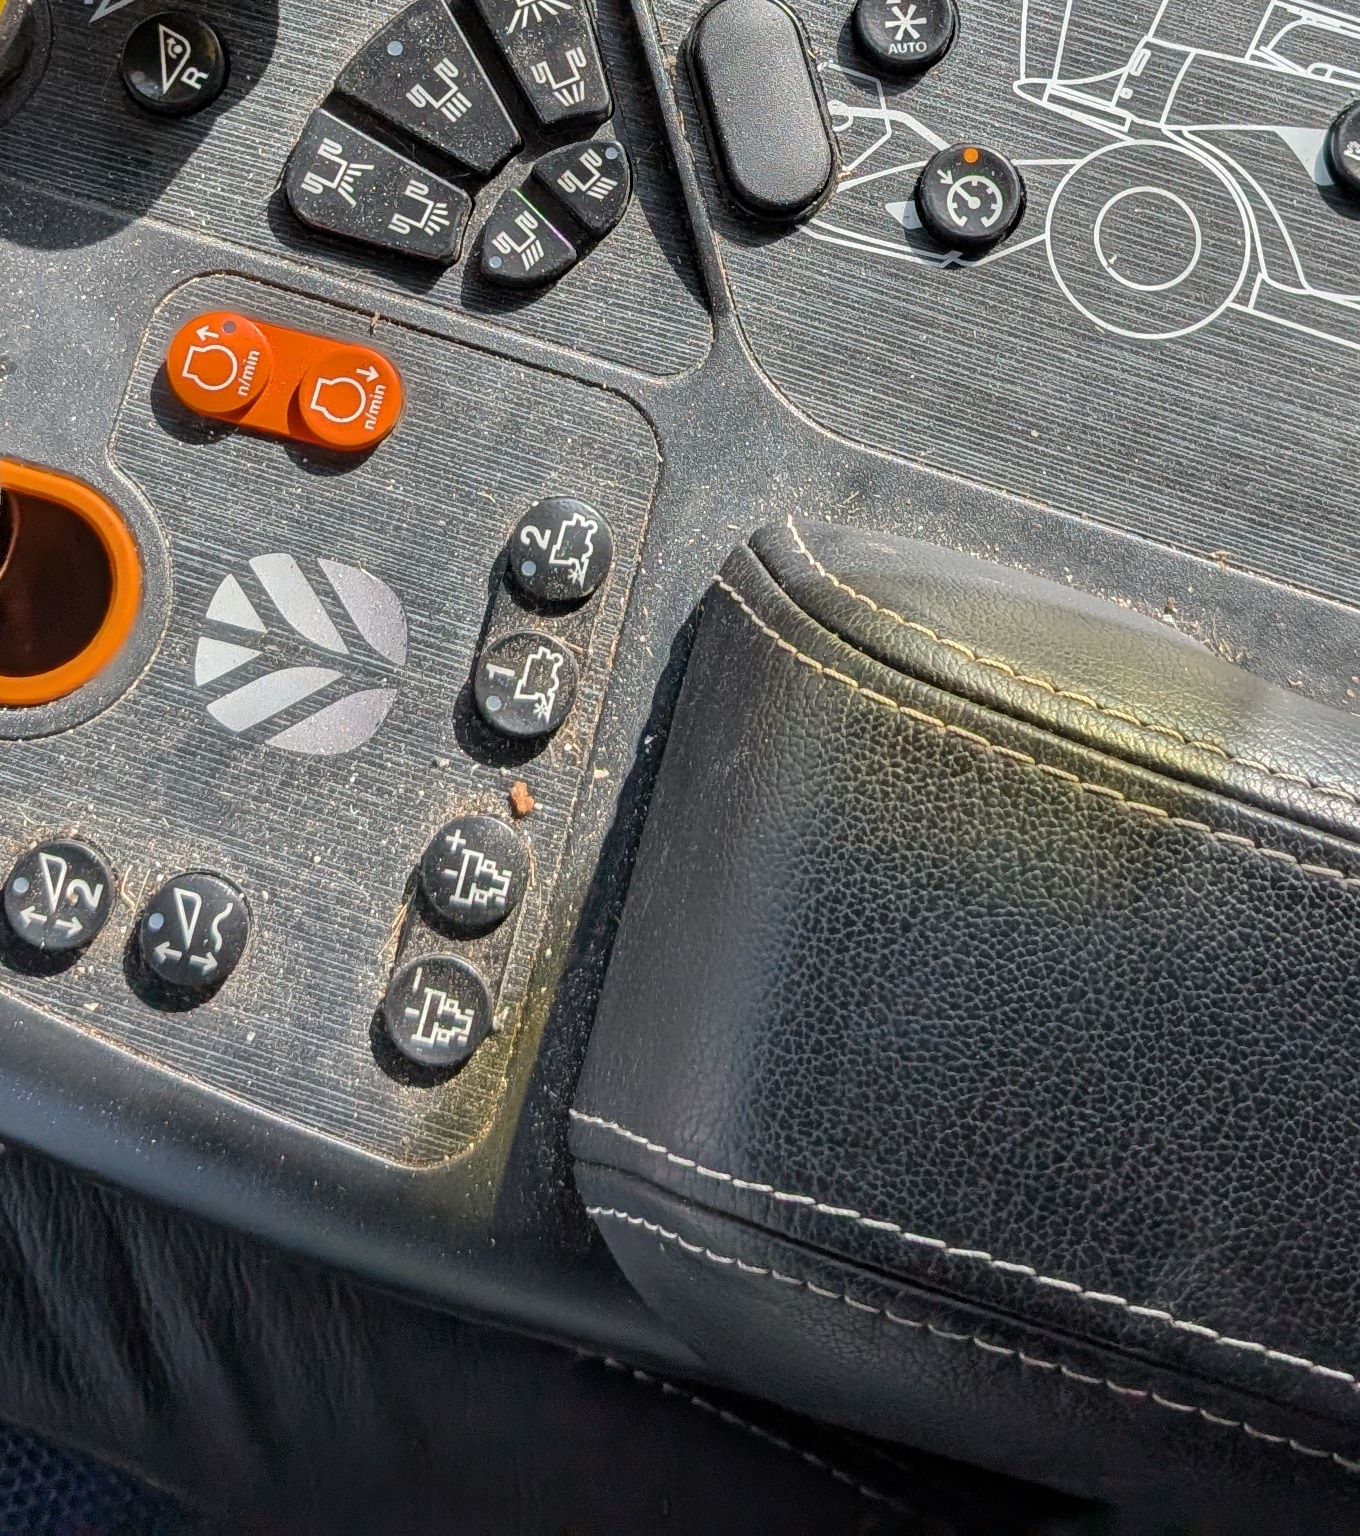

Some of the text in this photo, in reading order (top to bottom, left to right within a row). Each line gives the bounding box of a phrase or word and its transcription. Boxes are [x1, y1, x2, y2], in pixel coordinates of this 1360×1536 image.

[888, 41, 927, 55] AUTO
[180, 66, 210, 90] R
[237, 350, 261, 397] n/min
[364, 384, 387, 431] n/min
[520, 525, 552, 550] 2
[486, 662, 516, 679] 1
[65, 878, 104, 912] 2
